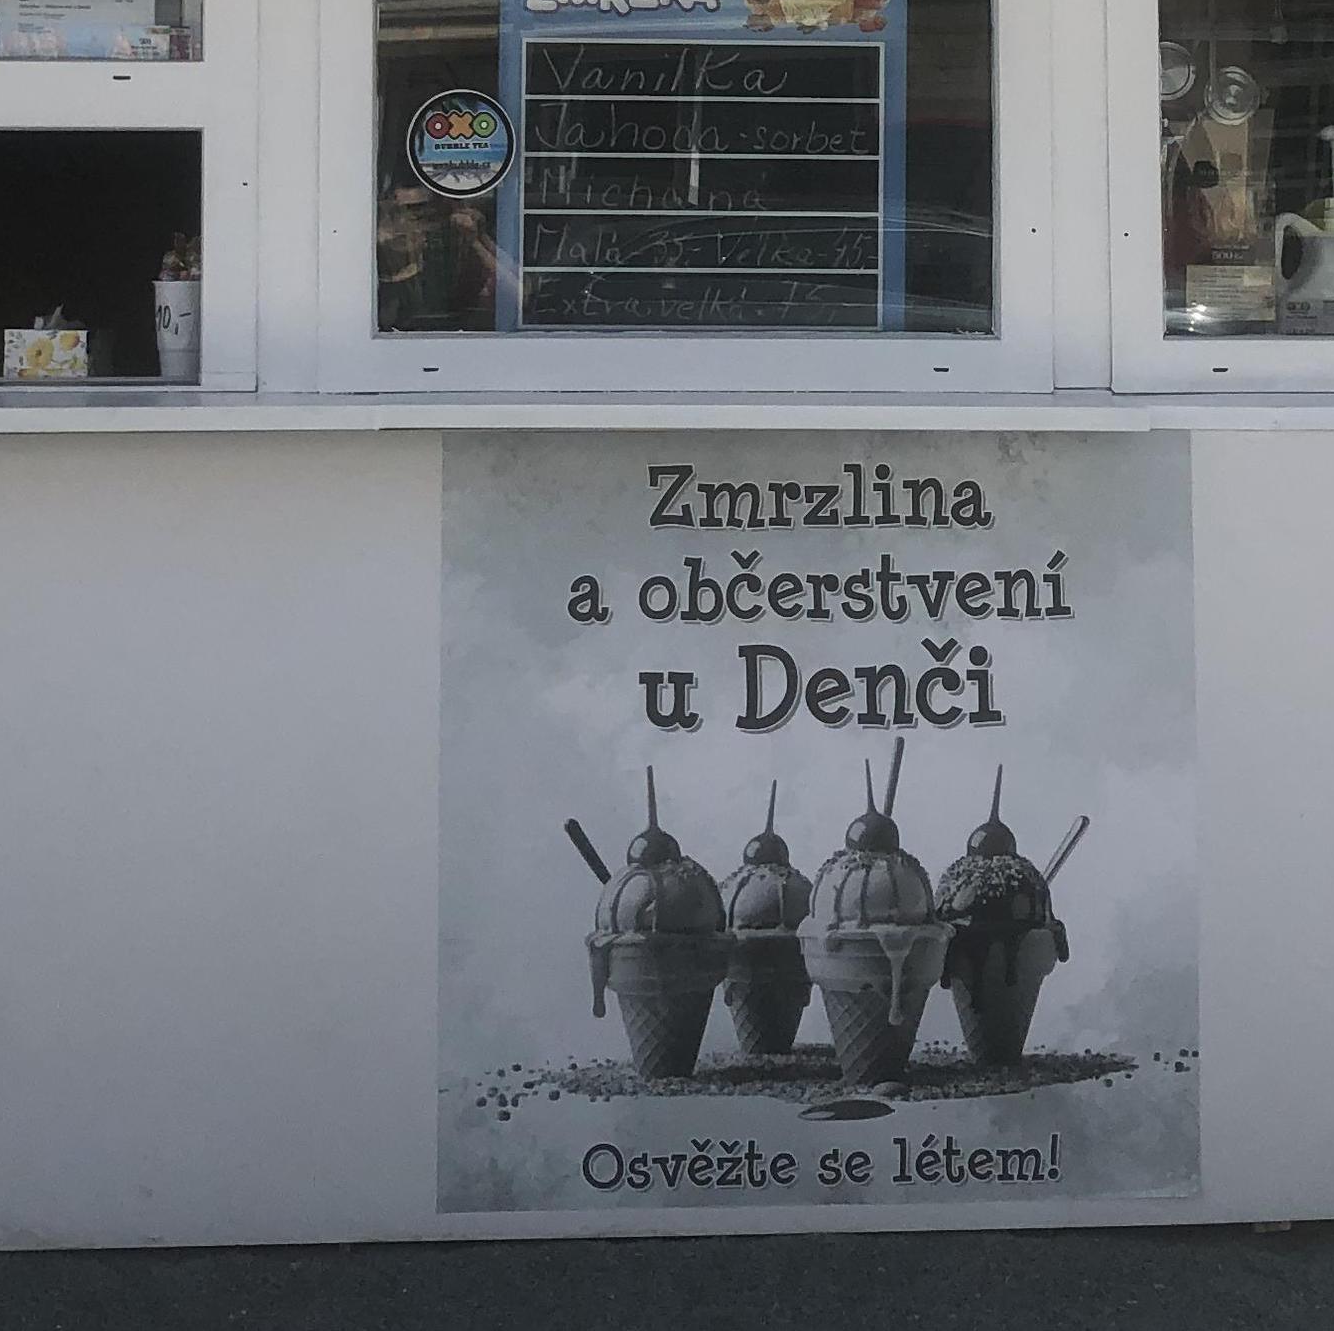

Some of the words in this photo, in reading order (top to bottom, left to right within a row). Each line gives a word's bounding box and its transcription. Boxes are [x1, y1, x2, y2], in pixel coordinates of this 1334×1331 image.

[426, 111, 498, 141] OXO
[647, 462, 994, 529] Zmrzlina
[567, 573, 611, 623] a
[638, 550, 1074, 623] občerstvení
[638, 670, 703, 730] u
[735, 637, 1006, 731] Denči
[582, 1138, 798, 1190] Osvěžte
[817, 1148, 873, 1186] se
[891, 1134, 1062, 1184] létem!
